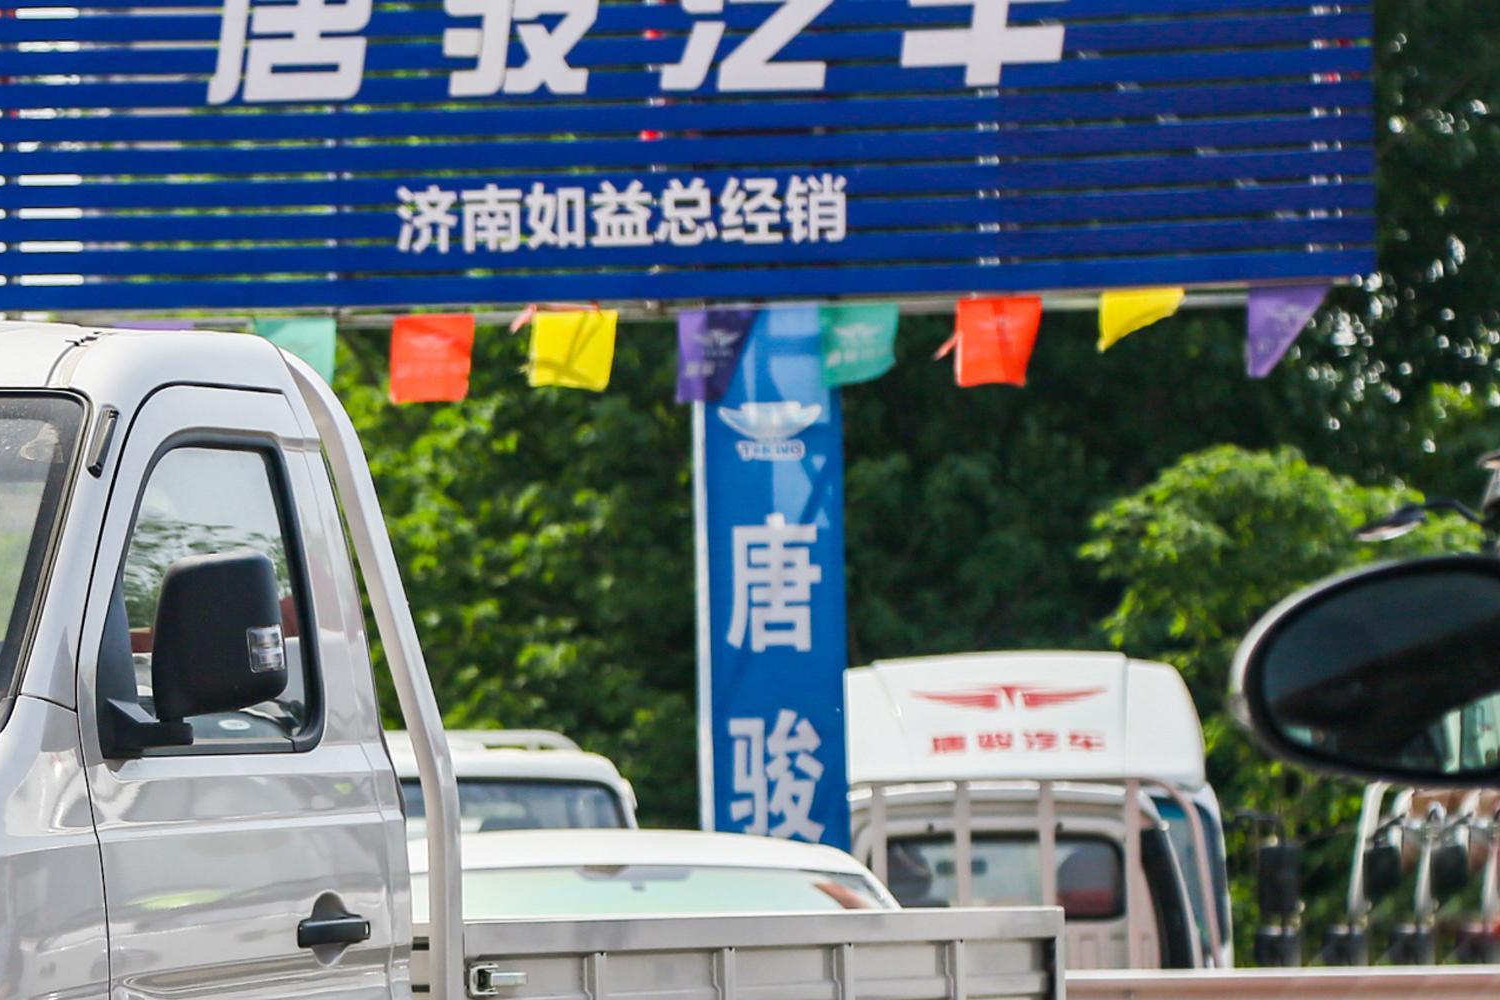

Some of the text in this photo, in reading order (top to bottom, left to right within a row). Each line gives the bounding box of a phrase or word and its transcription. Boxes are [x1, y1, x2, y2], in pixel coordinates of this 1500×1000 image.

[396, 175, 848, 254] 济南如益总经销
